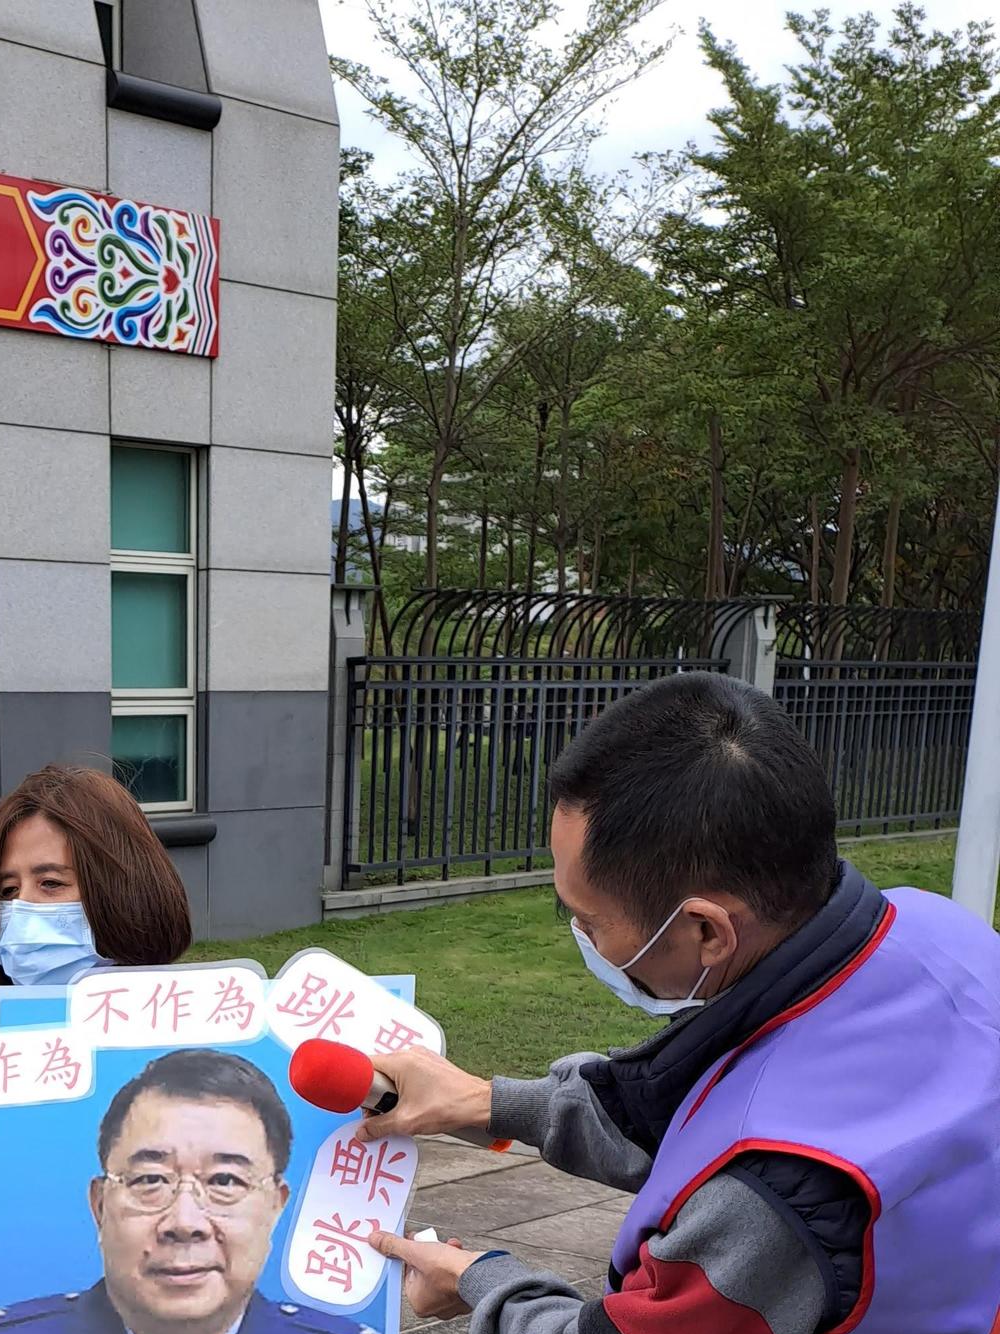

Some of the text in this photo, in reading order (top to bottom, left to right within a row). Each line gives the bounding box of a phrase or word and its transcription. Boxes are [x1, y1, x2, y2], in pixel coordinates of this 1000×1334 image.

[85, 975, 255, 1034] 不作為
[304, 1137, 407, 1293] 跳票
